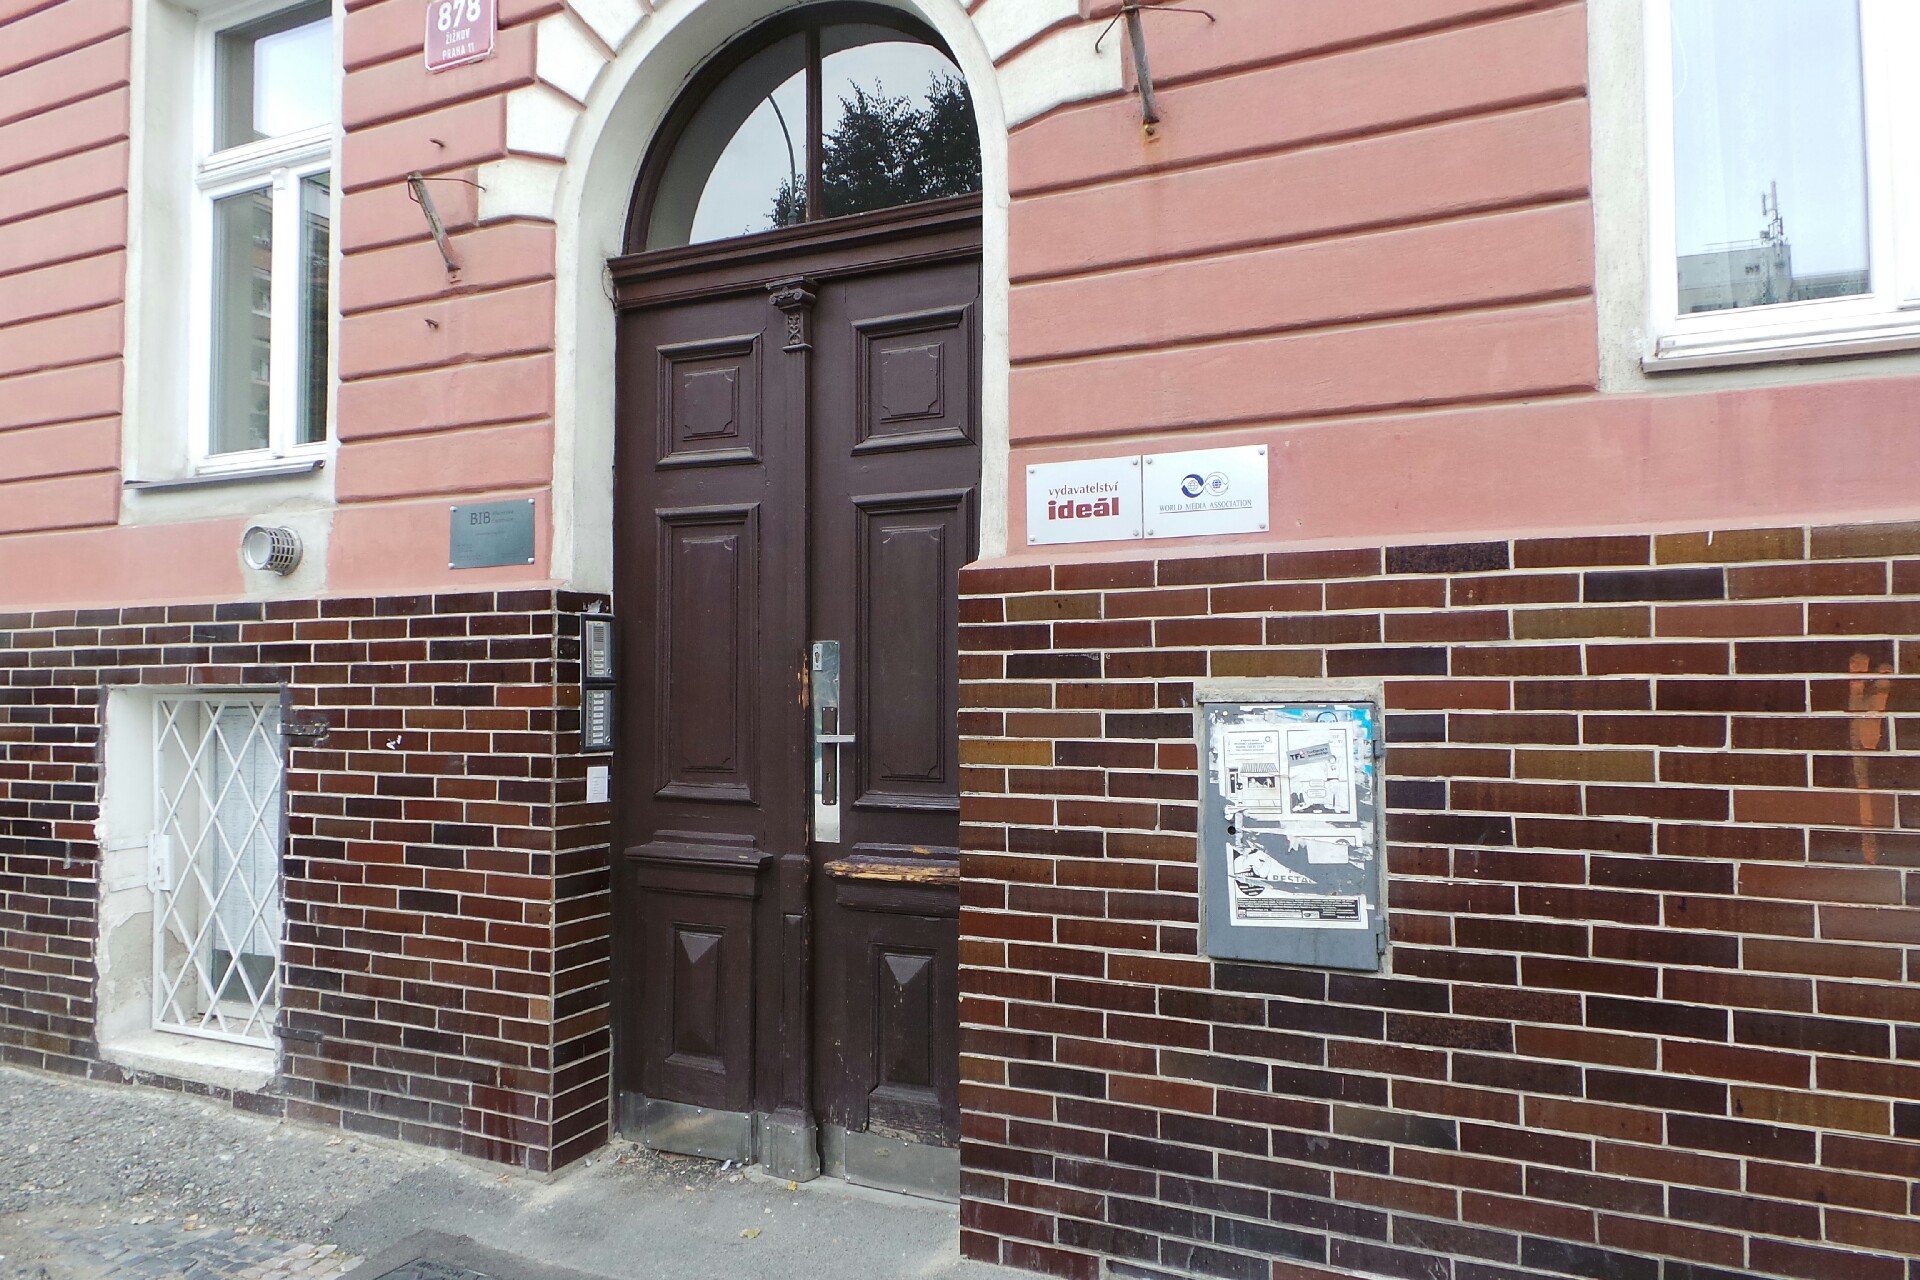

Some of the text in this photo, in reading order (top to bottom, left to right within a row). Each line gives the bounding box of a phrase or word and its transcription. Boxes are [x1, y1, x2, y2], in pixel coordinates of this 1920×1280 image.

[437, 0, 481, 31] 878
[446, 28, 471, 44] ŽIŽKOV
[442, 45, 466, 60] PRAHA
[1048, 481, 1119, 498] vydavatelství
[1048, 497, 1119, 520] ideál
[1159, 499, 1252, 512] WORLD MEDIA ASSOCIATION
[470, 511, 491, 525] BIB
